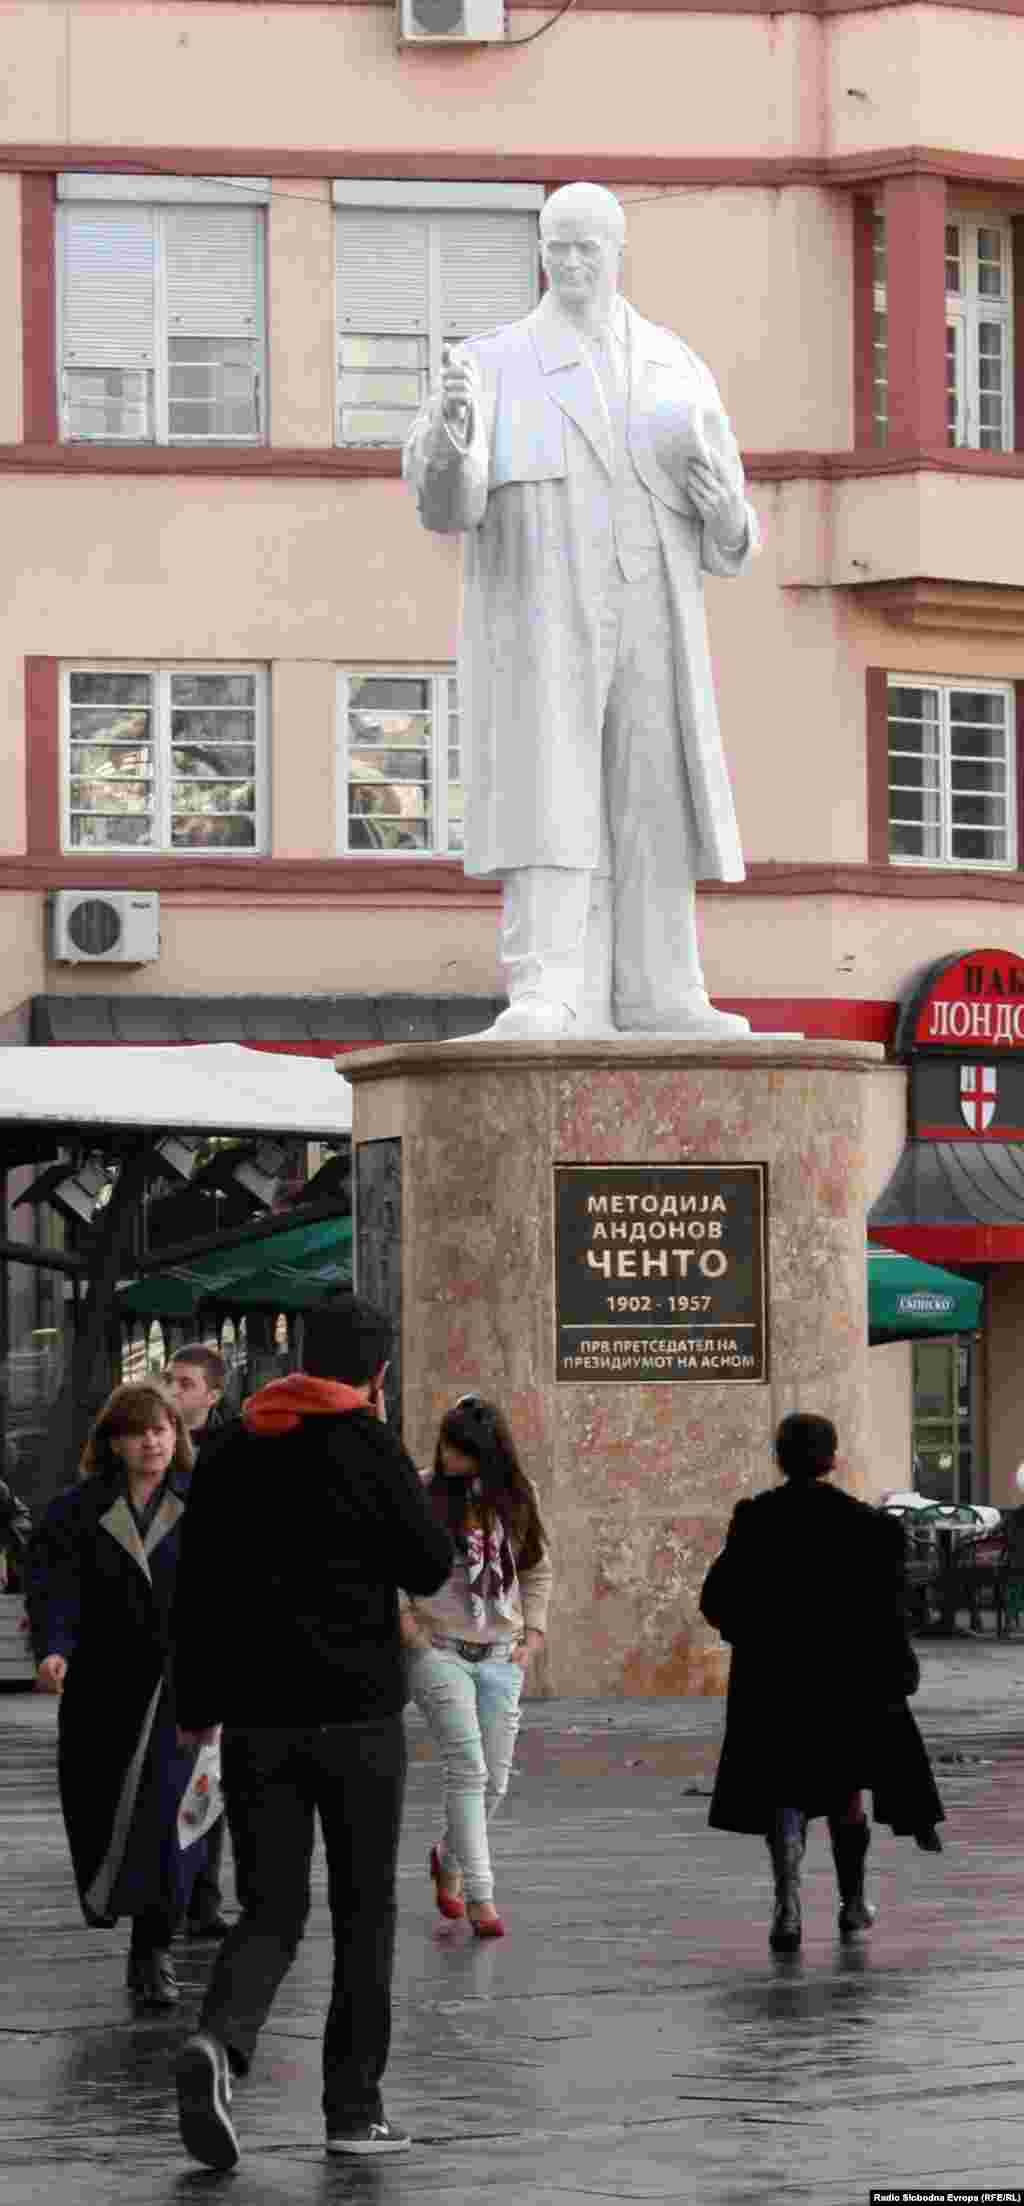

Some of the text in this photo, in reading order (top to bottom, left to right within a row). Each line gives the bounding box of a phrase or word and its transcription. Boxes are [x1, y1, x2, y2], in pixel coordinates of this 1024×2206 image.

[587, 1195, 727, 1216] МЕТОДИЈА
[592, 1221, 724, 1243] АНДОНОВ
[586, 1249, 728, 1278] ЧЕНТО
[606, 1296, 651, 1312] 1902
[668, 1296, 712, 1312] 1957
[580, 1340, 610, 1353] ПРВ
[717, 1339, 737, 1351] НА
[563, 1355, 755, 1371] ПРЕЗИДИУМОТ НА АСНОМ
